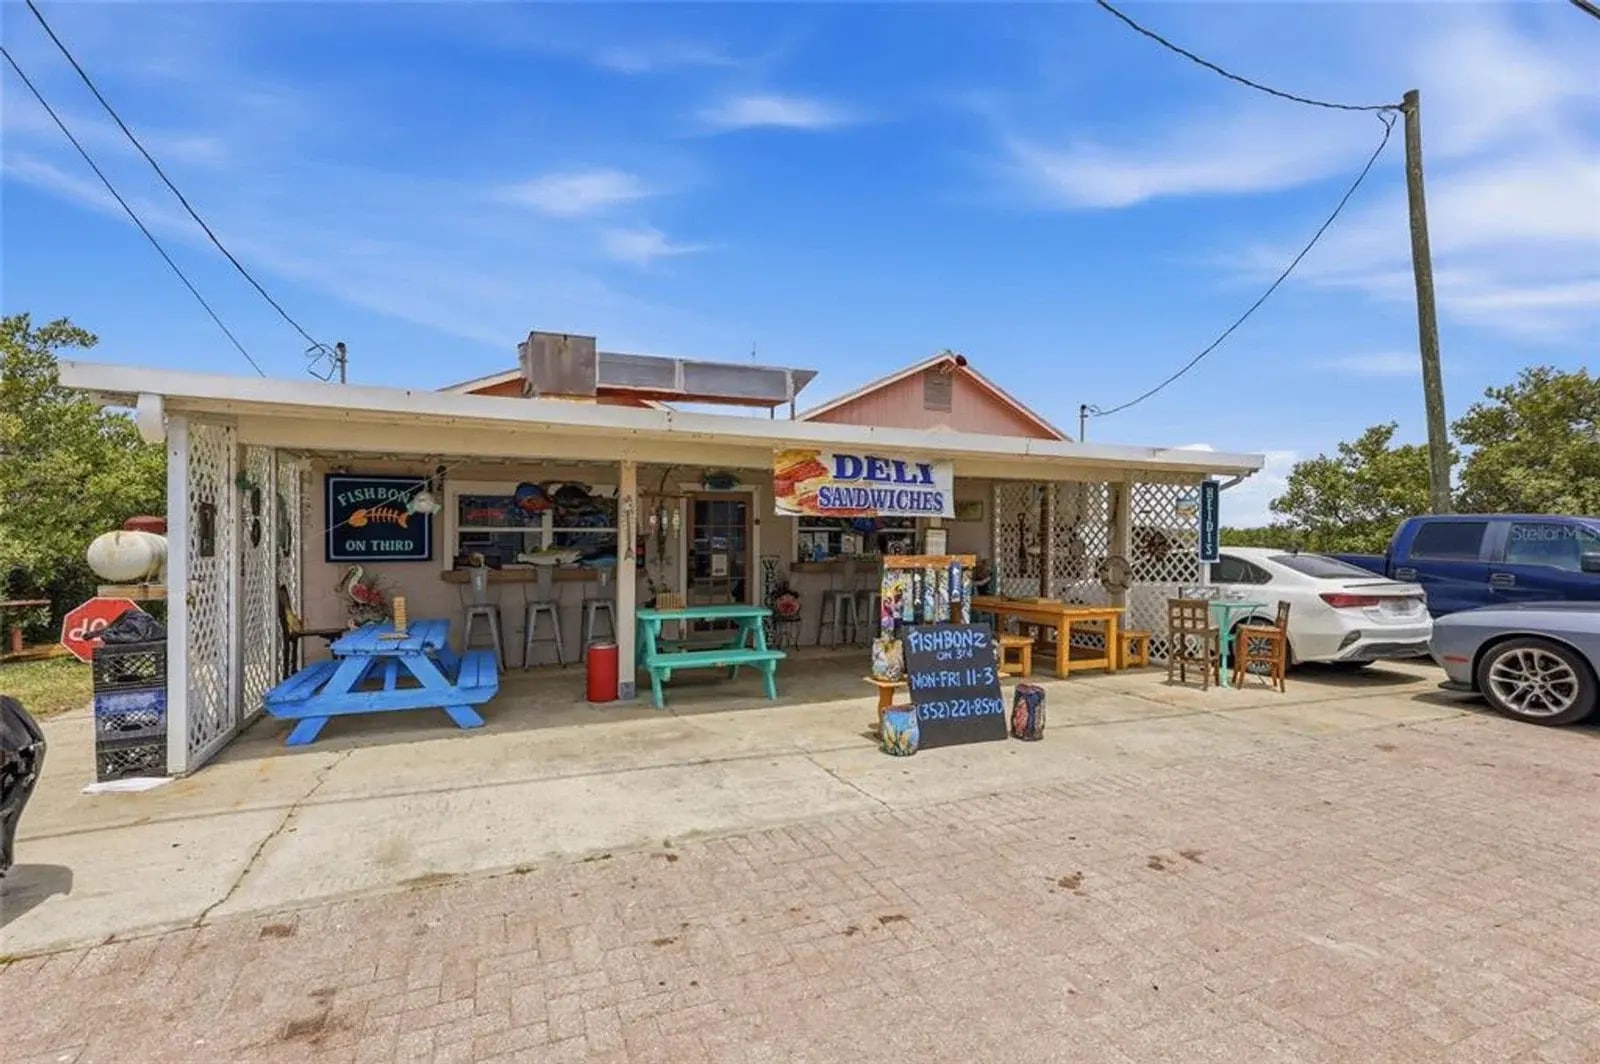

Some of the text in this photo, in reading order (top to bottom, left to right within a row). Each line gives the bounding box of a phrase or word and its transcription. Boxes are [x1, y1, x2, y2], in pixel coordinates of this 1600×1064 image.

[832, 453, 935, 485] DELI
[337, 487, 411, 507] FISHBON
[819, 485, 944, 511] SANDWICHES
[345, 540, 414, 551] ON THIRD
[907, 629, 987, 654] FISHBONZ
[966, 667, 994, 686] 11-3
